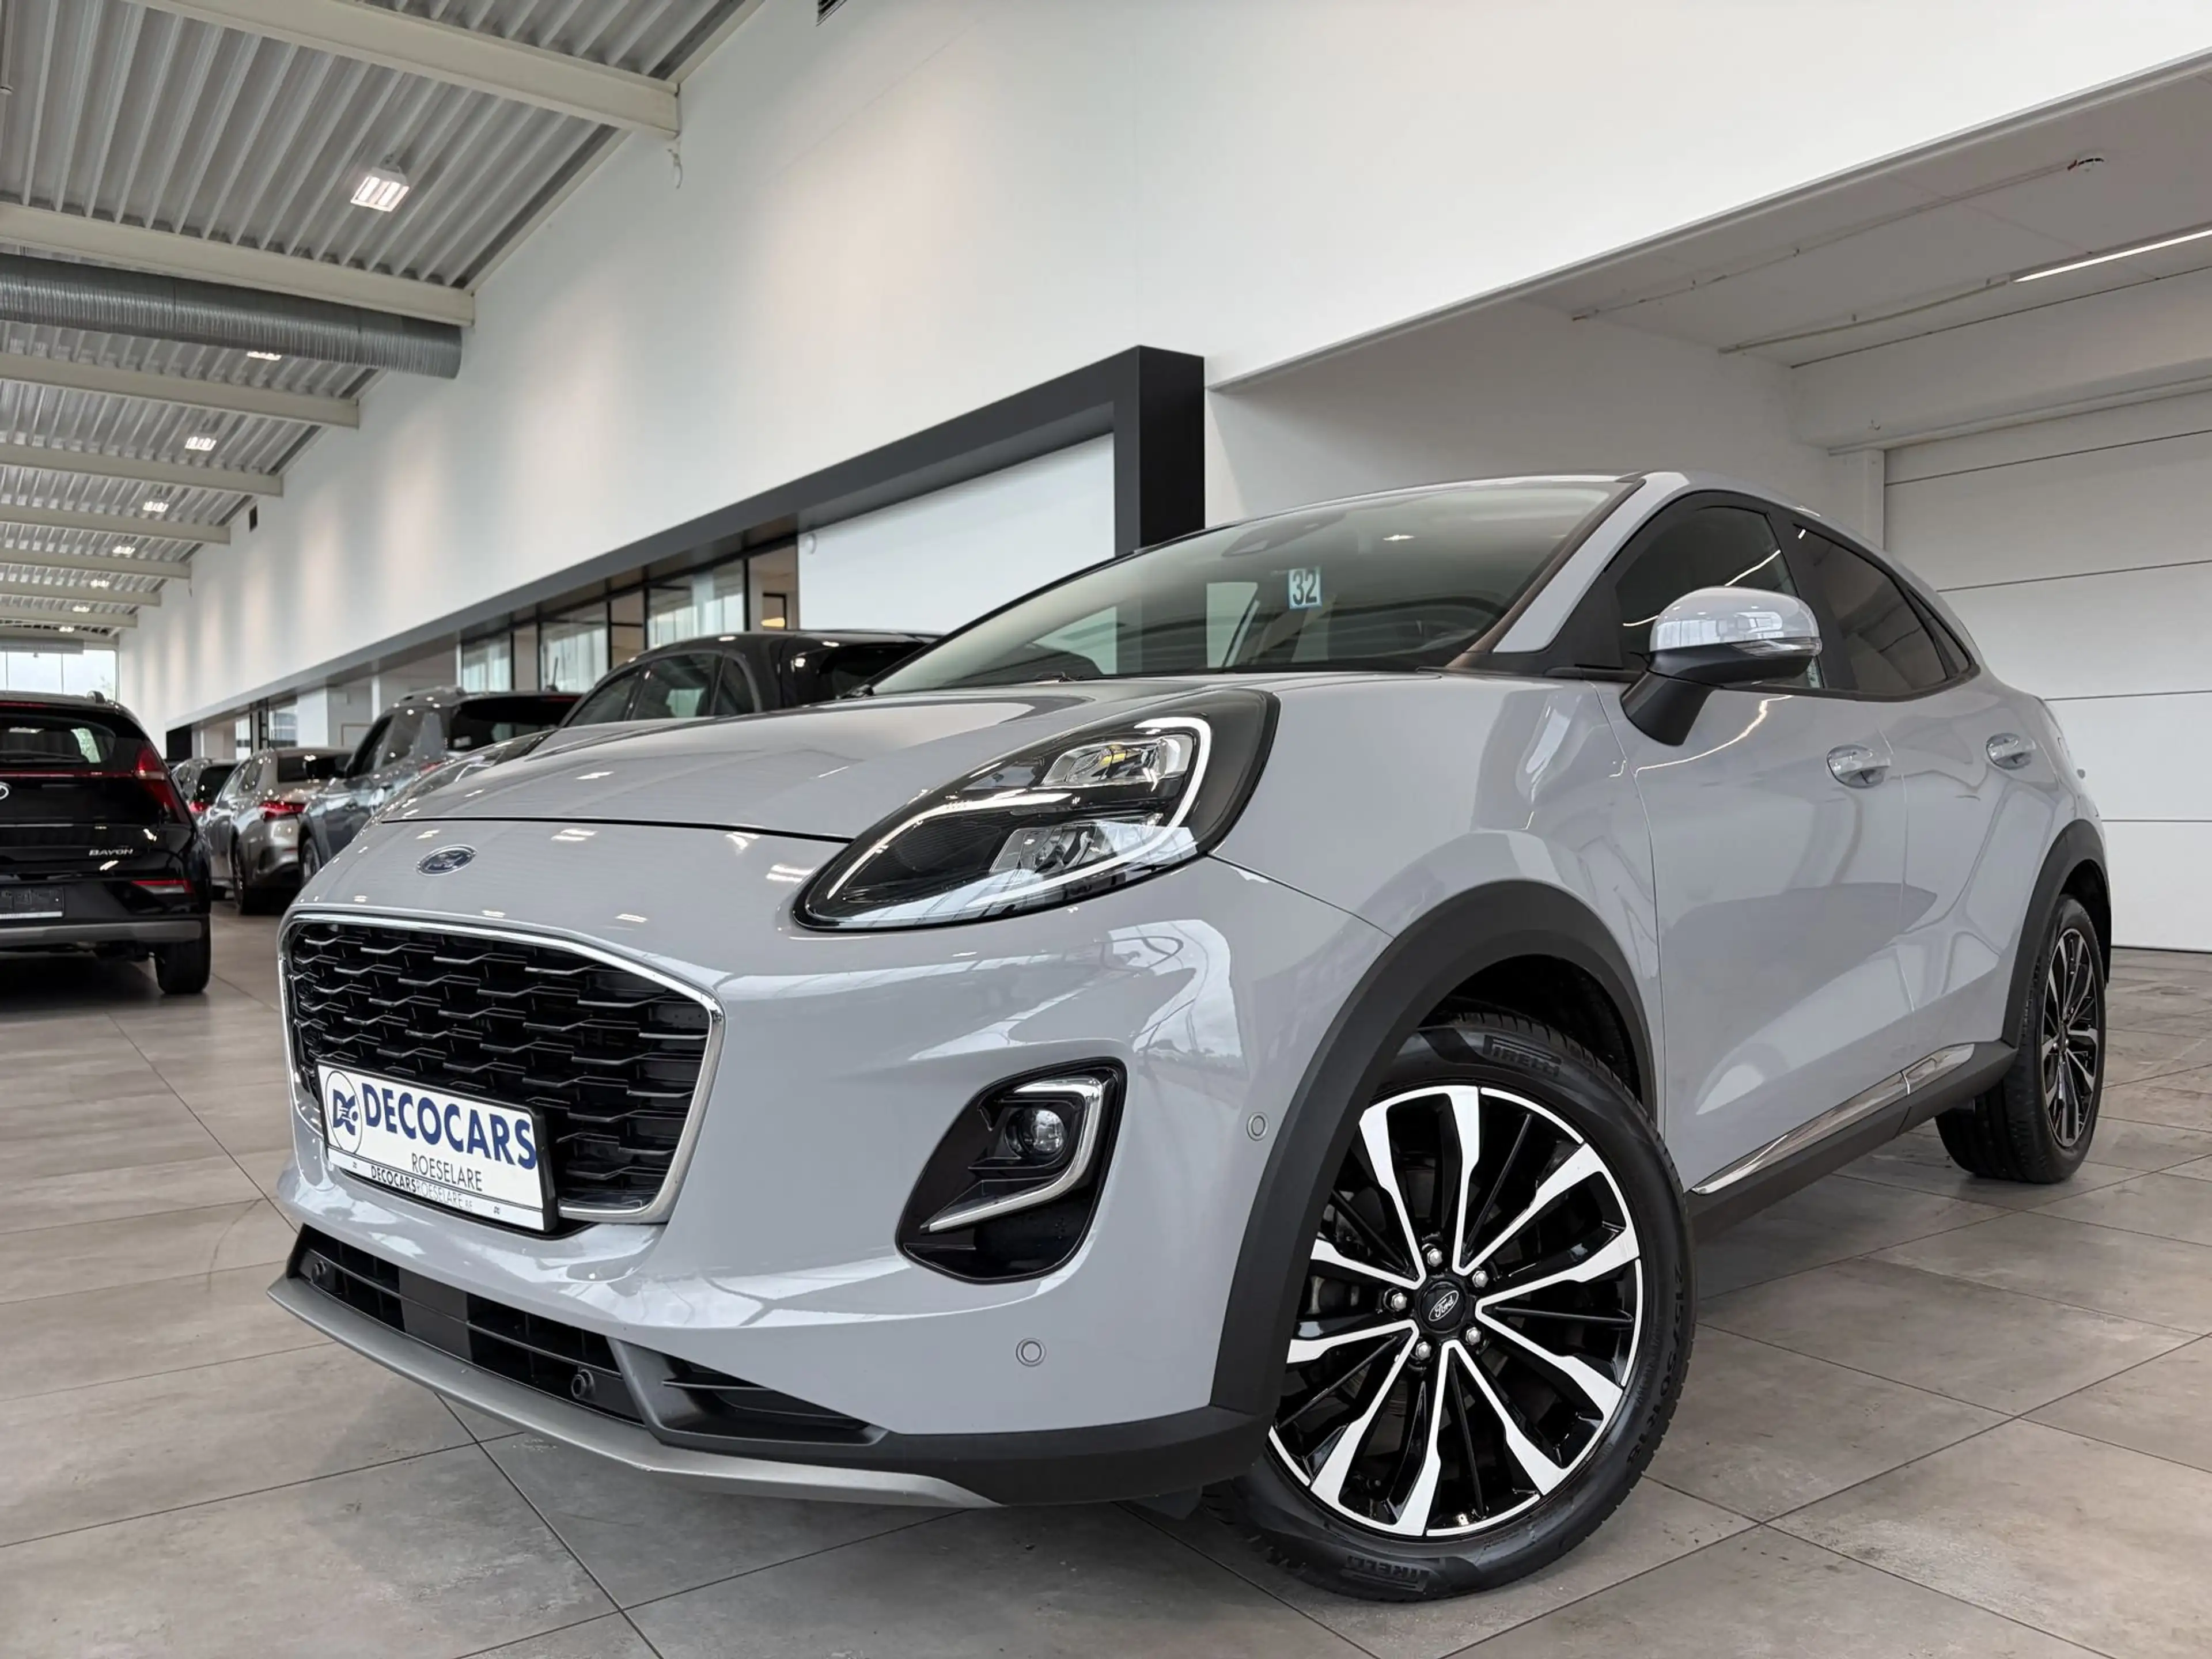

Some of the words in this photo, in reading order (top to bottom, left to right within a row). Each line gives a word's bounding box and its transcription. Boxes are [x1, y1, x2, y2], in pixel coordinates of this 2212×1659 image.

[1293, 570, 1317, 605] 32
[89, 848, 134, 857] BAYON
[1483, 1035, 1562, 1077] PIRELLI
[362, 1083, 537, 1170] DECOCARS
[411, 1153, 483, 1191] ROESELARE
[1434, 1295, 1454, 1317] Ford
